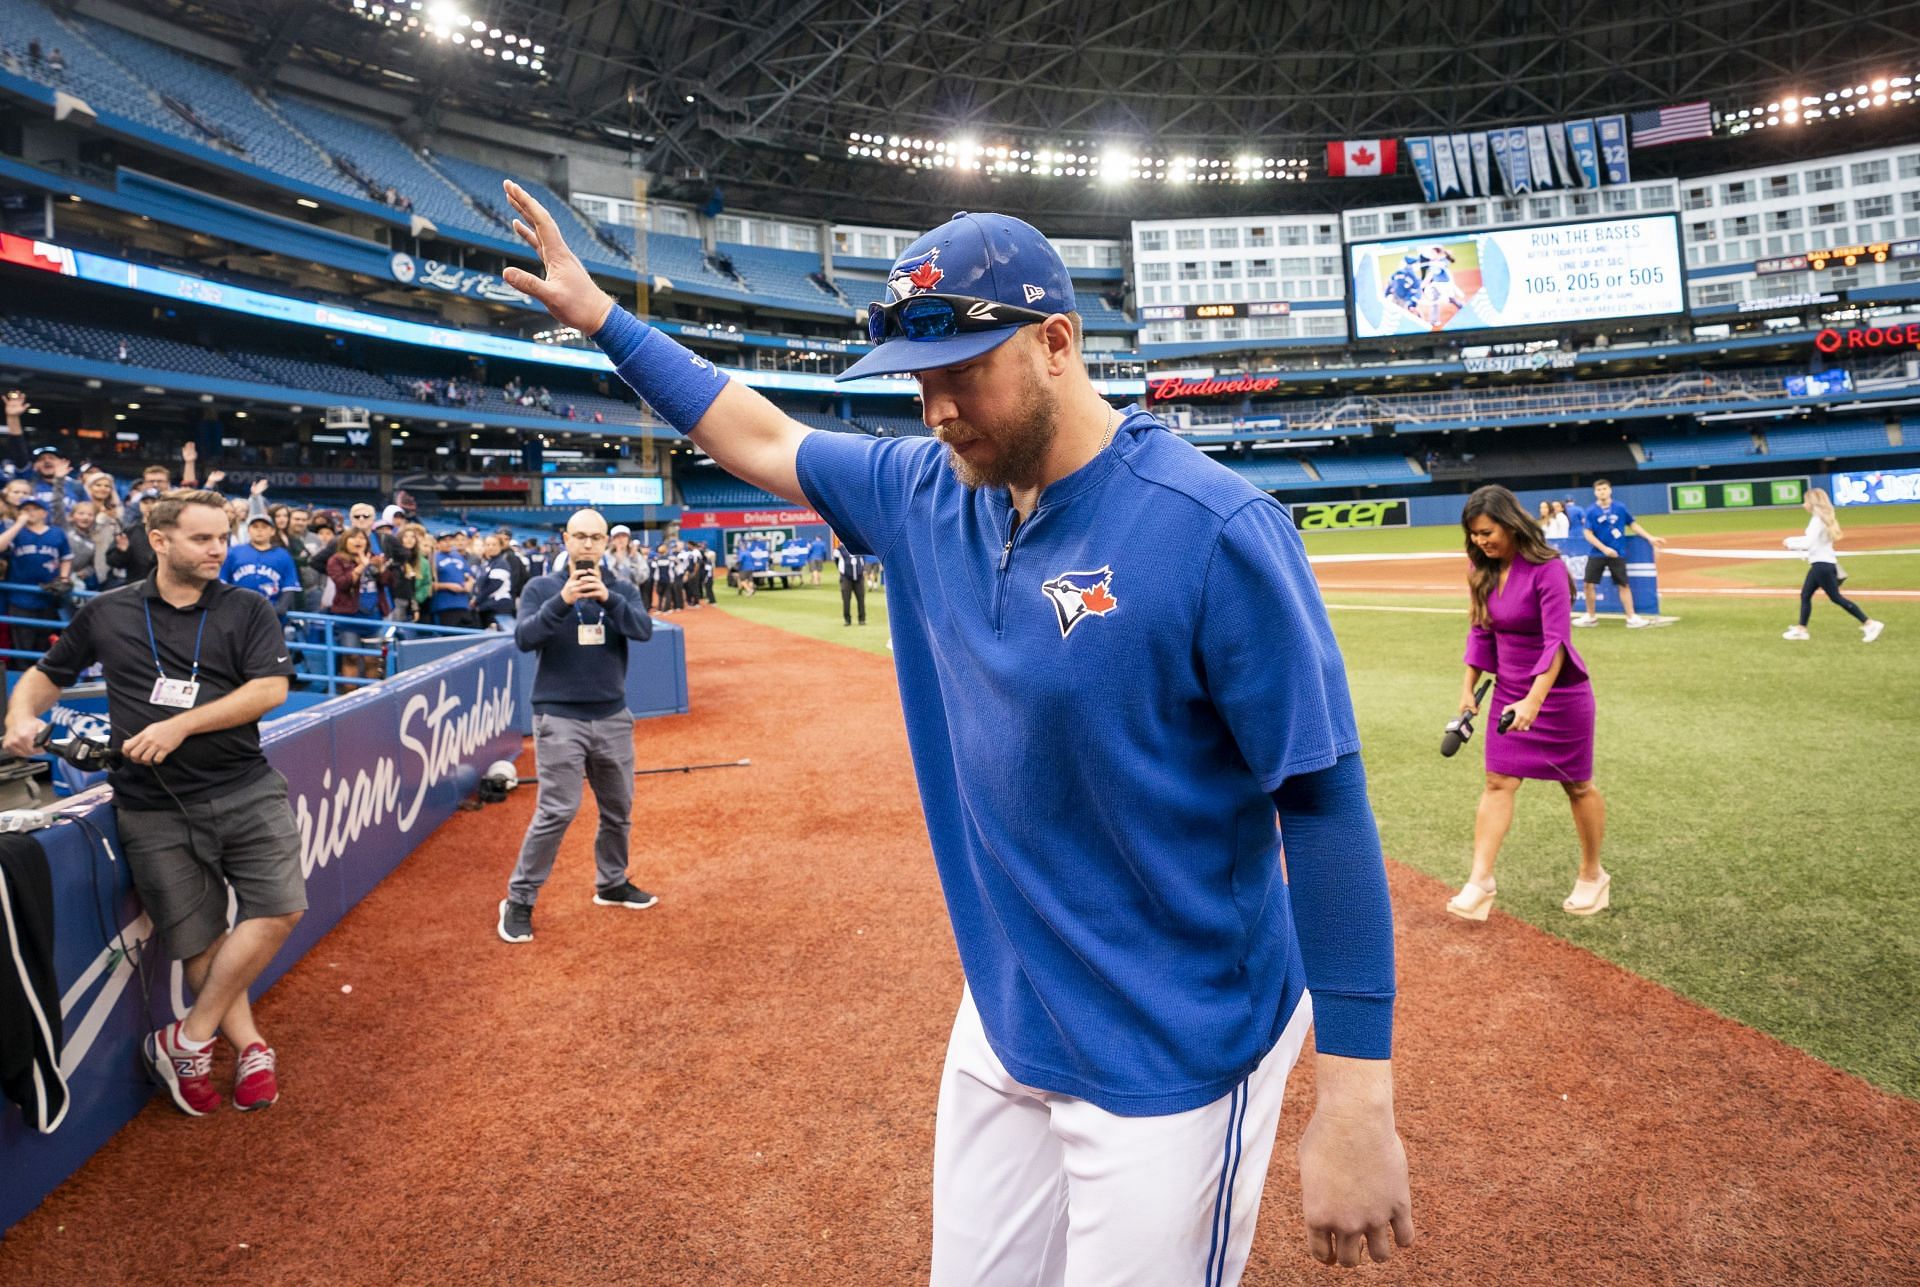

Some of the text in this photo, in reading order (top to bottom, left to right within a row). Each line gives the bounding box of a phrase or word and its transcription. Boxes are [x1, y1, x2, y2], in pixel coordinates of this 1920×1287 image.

[1531, 224, 1641, 247] RUN THE BASES
[1566, 272, 1599, 291] 205
[1606, 276, 1623, 288] or
[1629, 266, 1664, 286] 505
[1848, 324, 1920, 348] ROGE
[1466, 358, 1528, 372] WESTJET
[1148, 373, 1279, 400] Budweiser
[314, 471, 345, 487] BLUE
[348, 473, 379, 488] JAYS
[1681, 490, 1702, 505] TD
[1727, 487, 1749, 502] TD
[1775, 485, 1798, 501] TD
[744, 512, 779, 524] Driving
[779, 510, 817, 523] Canada
[1301, 501, 1398, 530] acer
[398, 658, 515, 832] Standard
